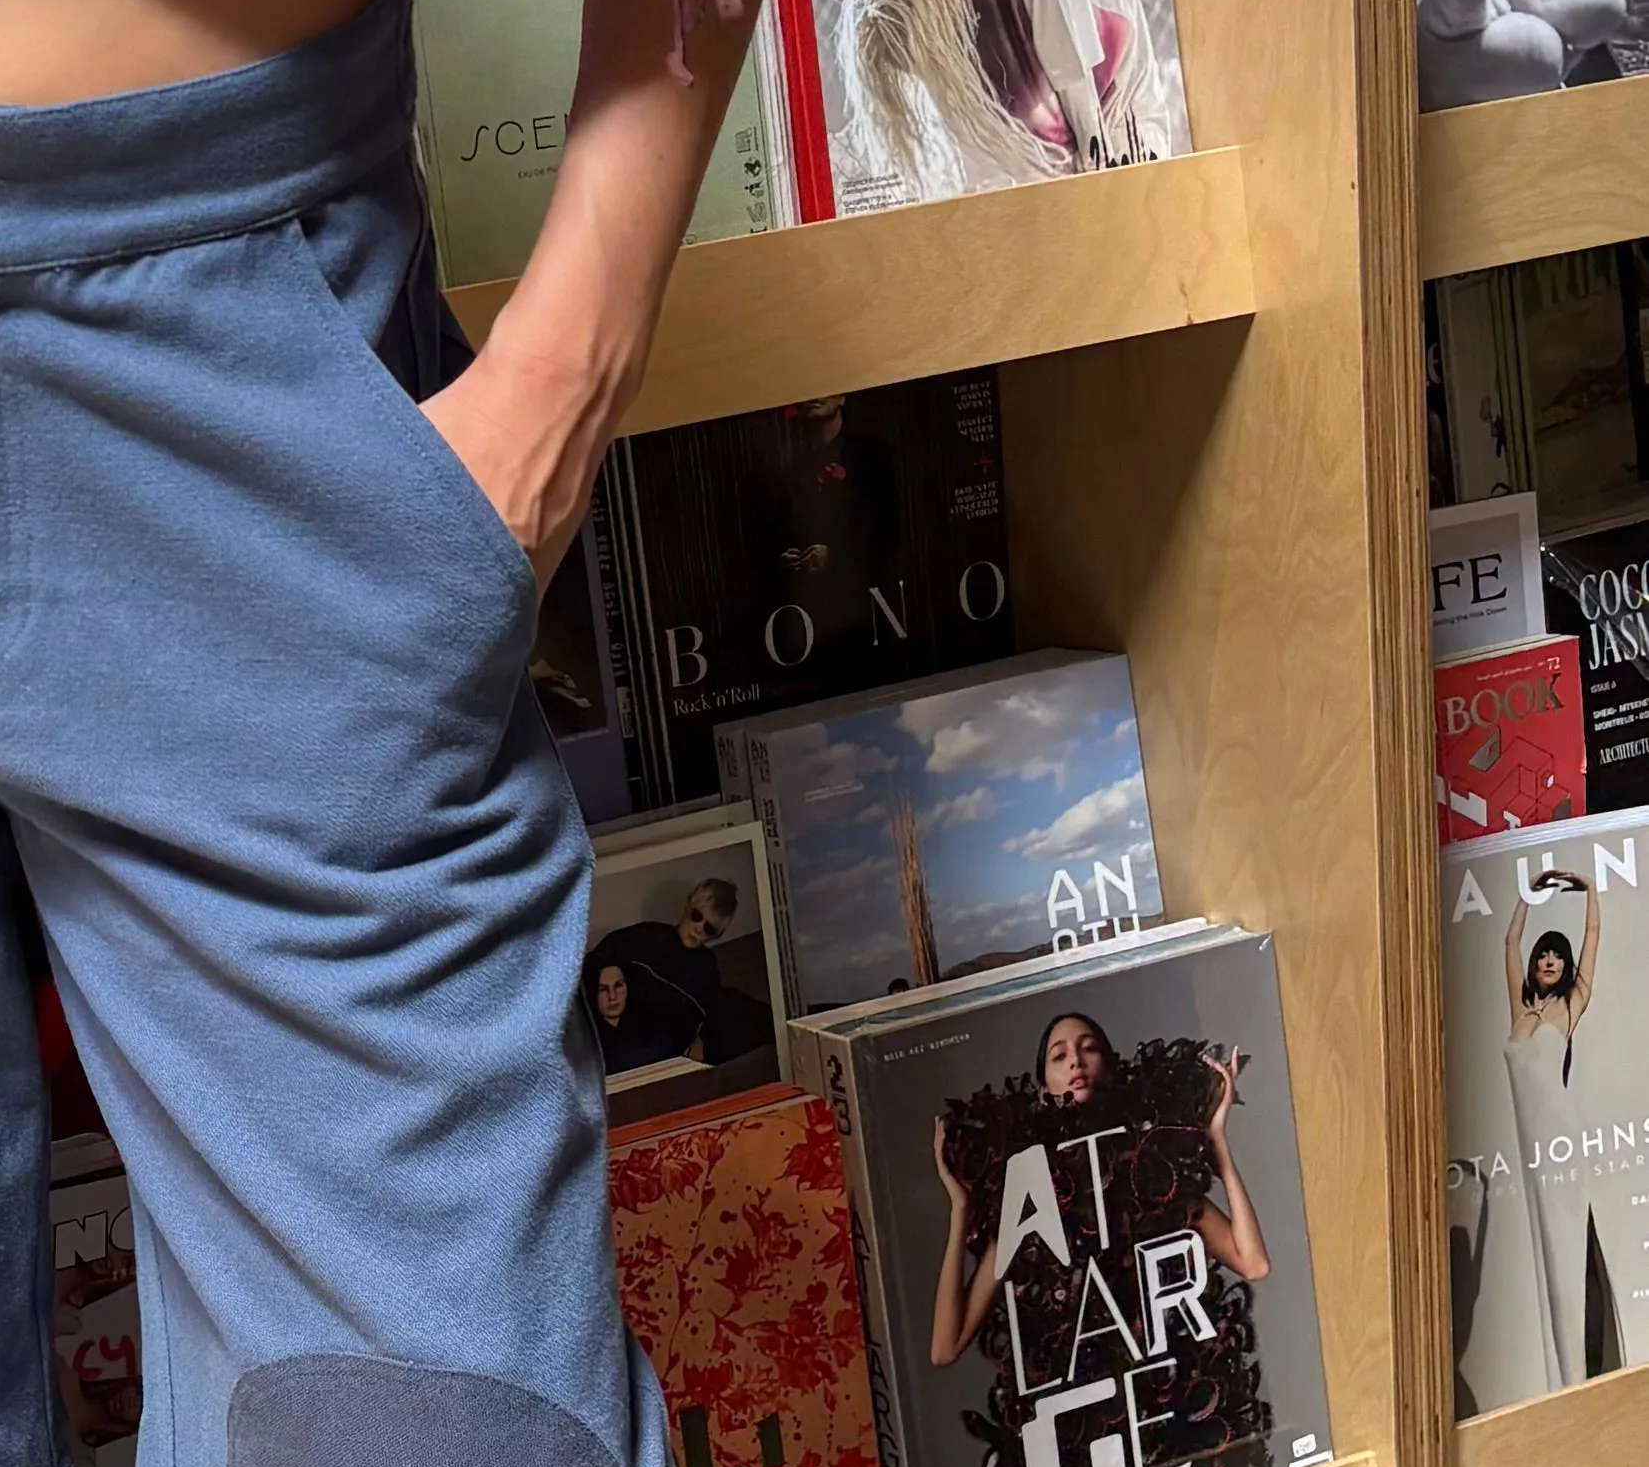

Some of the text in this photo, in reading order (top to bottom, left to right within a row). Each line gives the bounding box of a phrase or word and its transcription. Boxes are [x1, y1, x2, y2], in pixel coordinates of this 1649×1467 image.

[663, 559, 1007, 689] BONO
[673, 692, 713, 717] Rock
[731, 683, 761, 703] Roll
[1438, 672, 1566, 736] BOOK
[1047, 854, 1140, 928] AN
[993, 1124, 1128, 1282] AT
